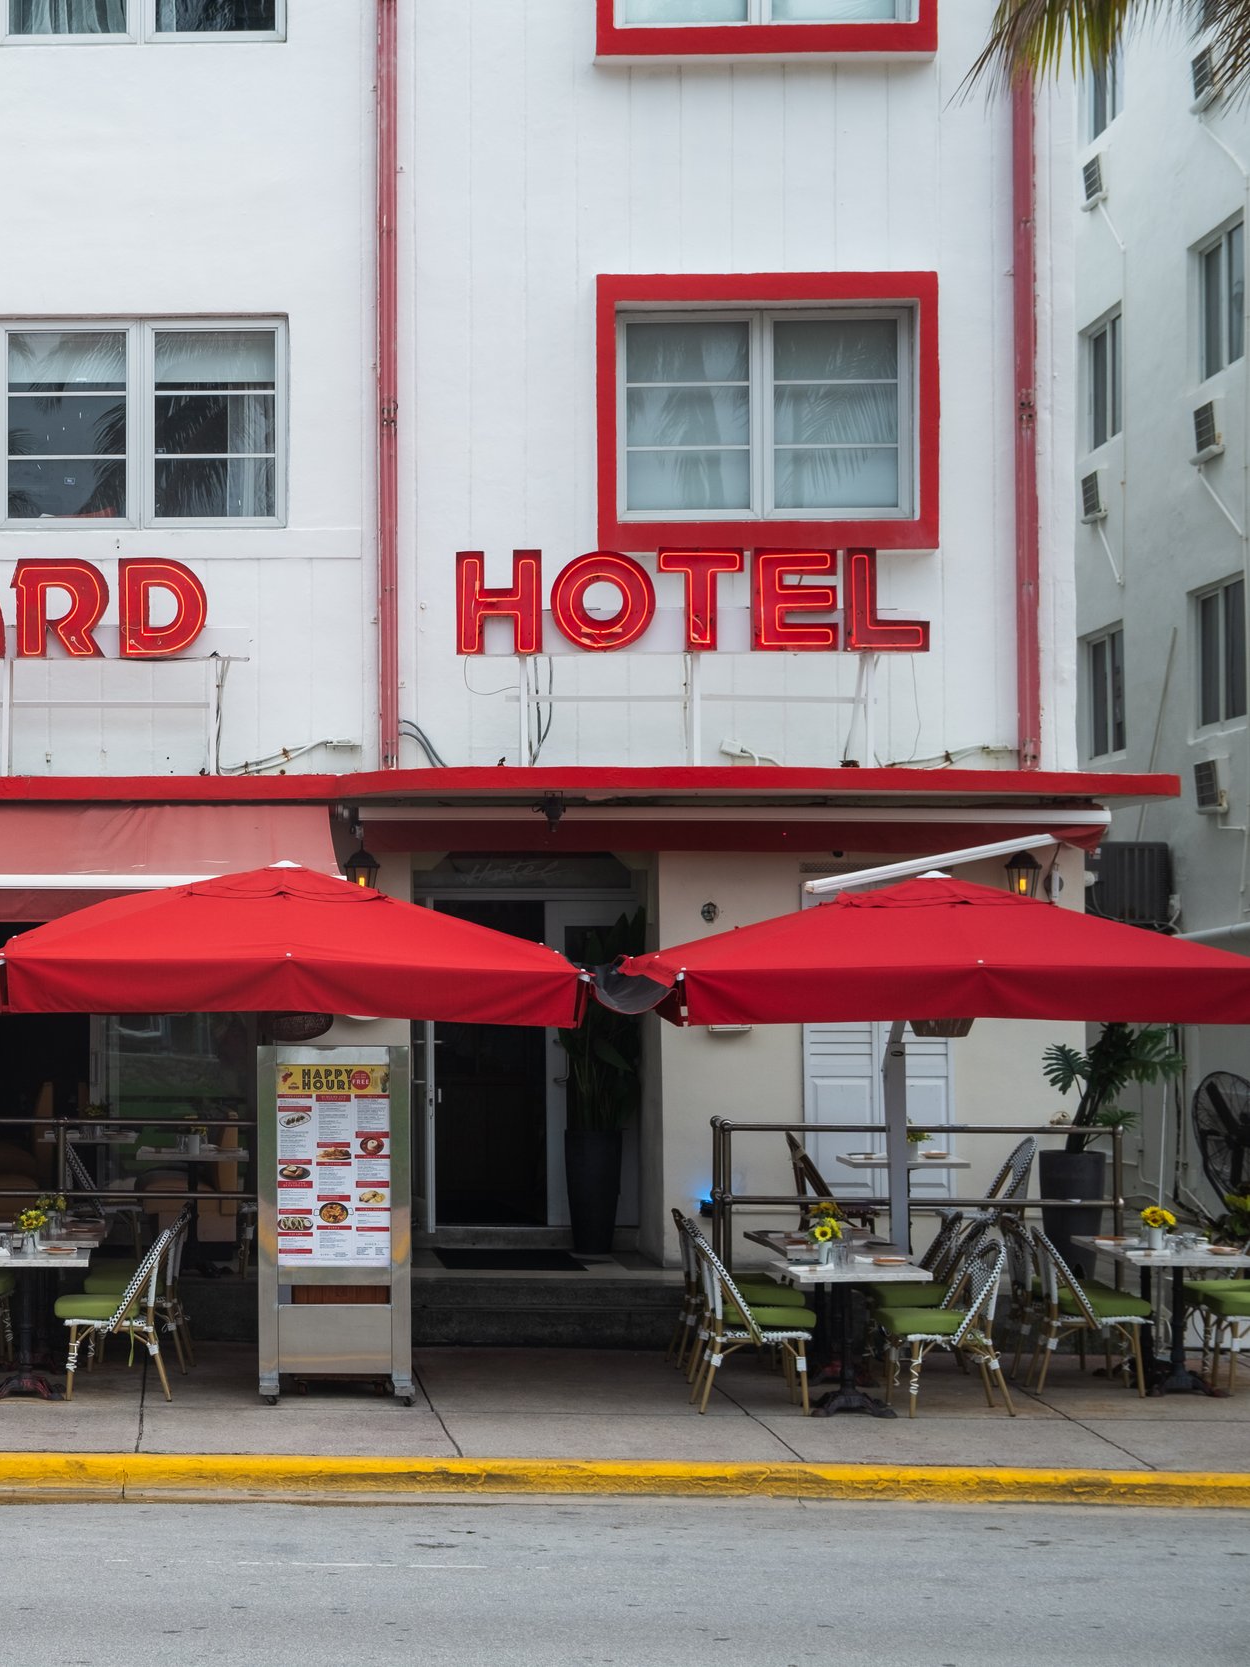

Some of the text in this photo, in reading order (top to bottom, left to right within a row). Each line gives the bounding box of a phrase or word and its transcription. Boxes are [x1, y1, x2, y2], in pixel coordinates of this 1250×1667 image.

[455, 547, 931, 656] HOTEL
[302, 1069, 353, 1080] HAPPY
[302, 1080, 352, 1090] HOUR!
